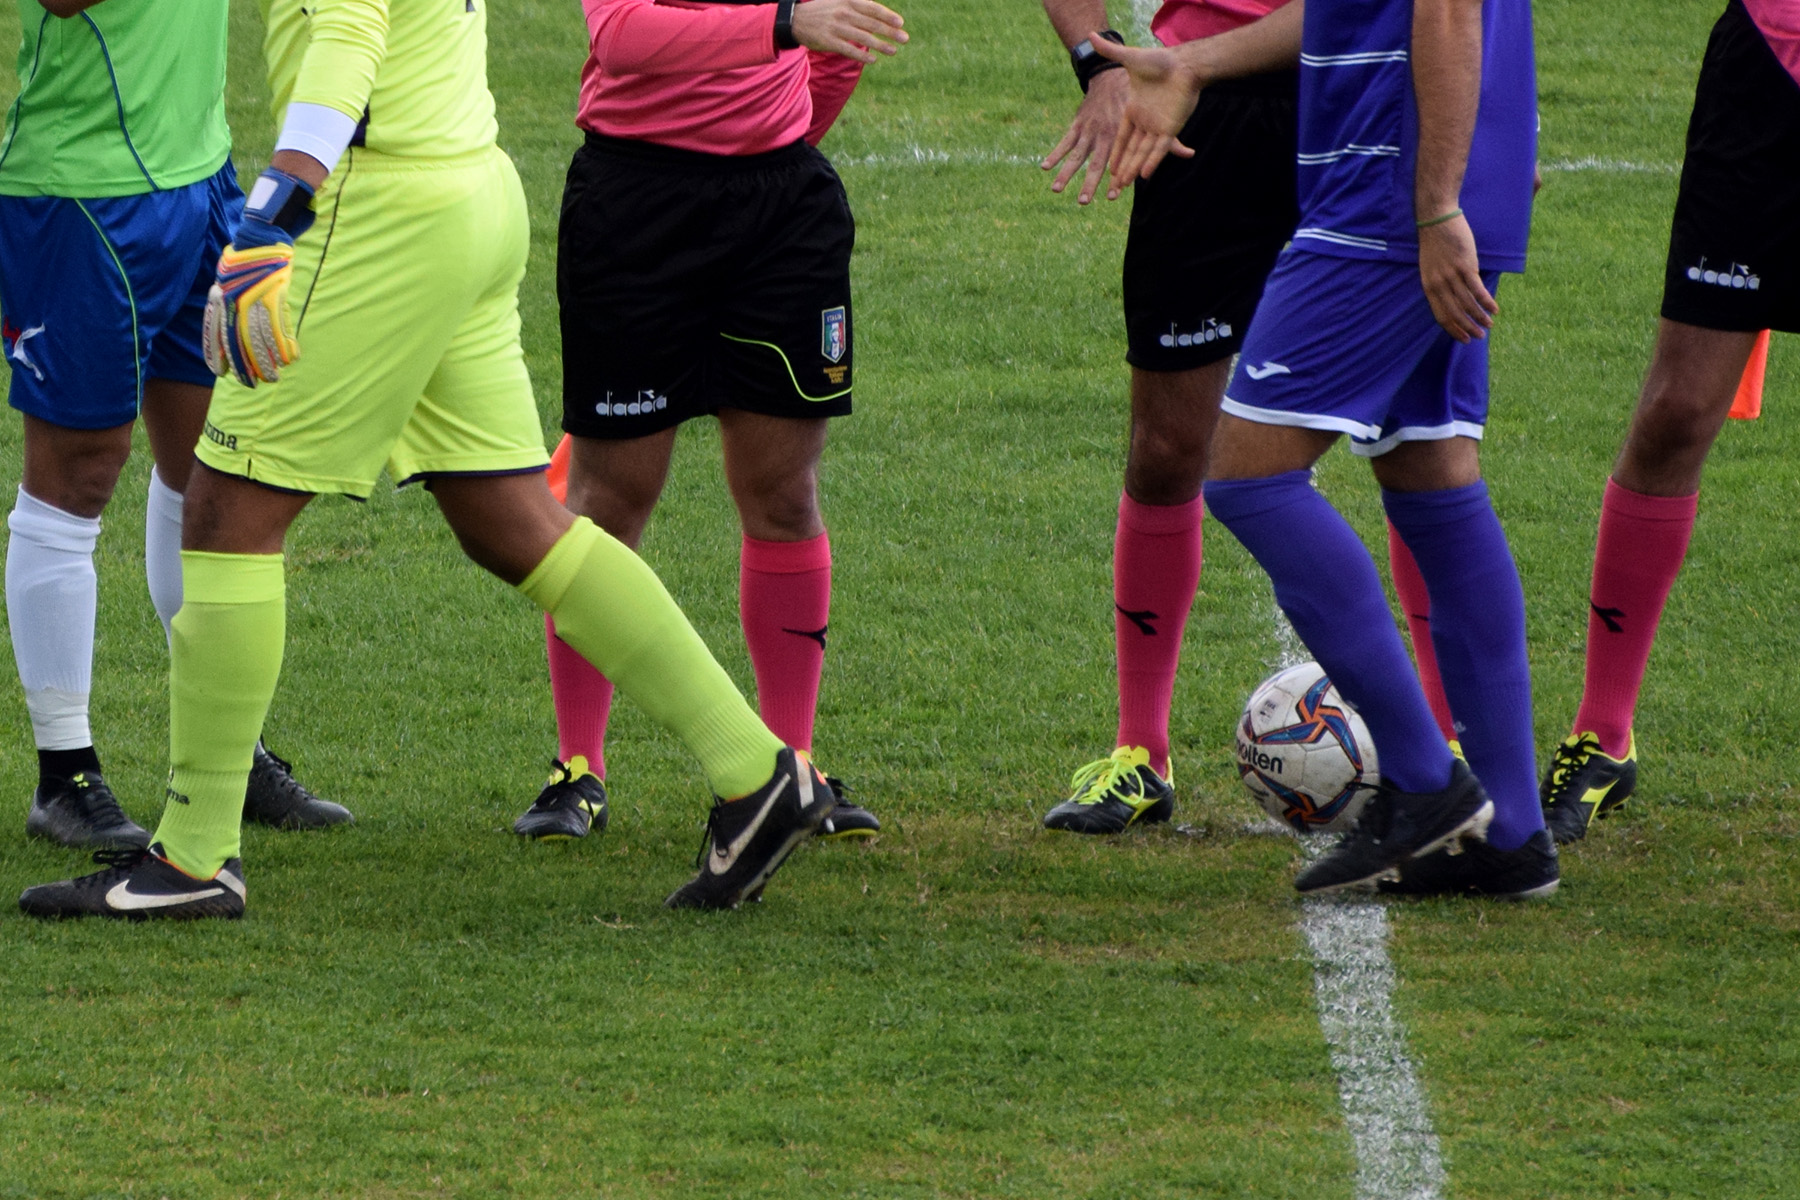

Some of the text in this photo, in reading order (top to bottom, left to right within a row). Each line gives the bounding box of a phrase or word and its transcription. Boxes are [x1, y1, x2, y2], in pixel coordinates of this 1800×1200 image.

[1687, 255, 1761, 291] diadora
[1160, 317, 1233, 348] diadora
[595, 389, 667, 417] diadora
[203, 418, 238, 451] oma
